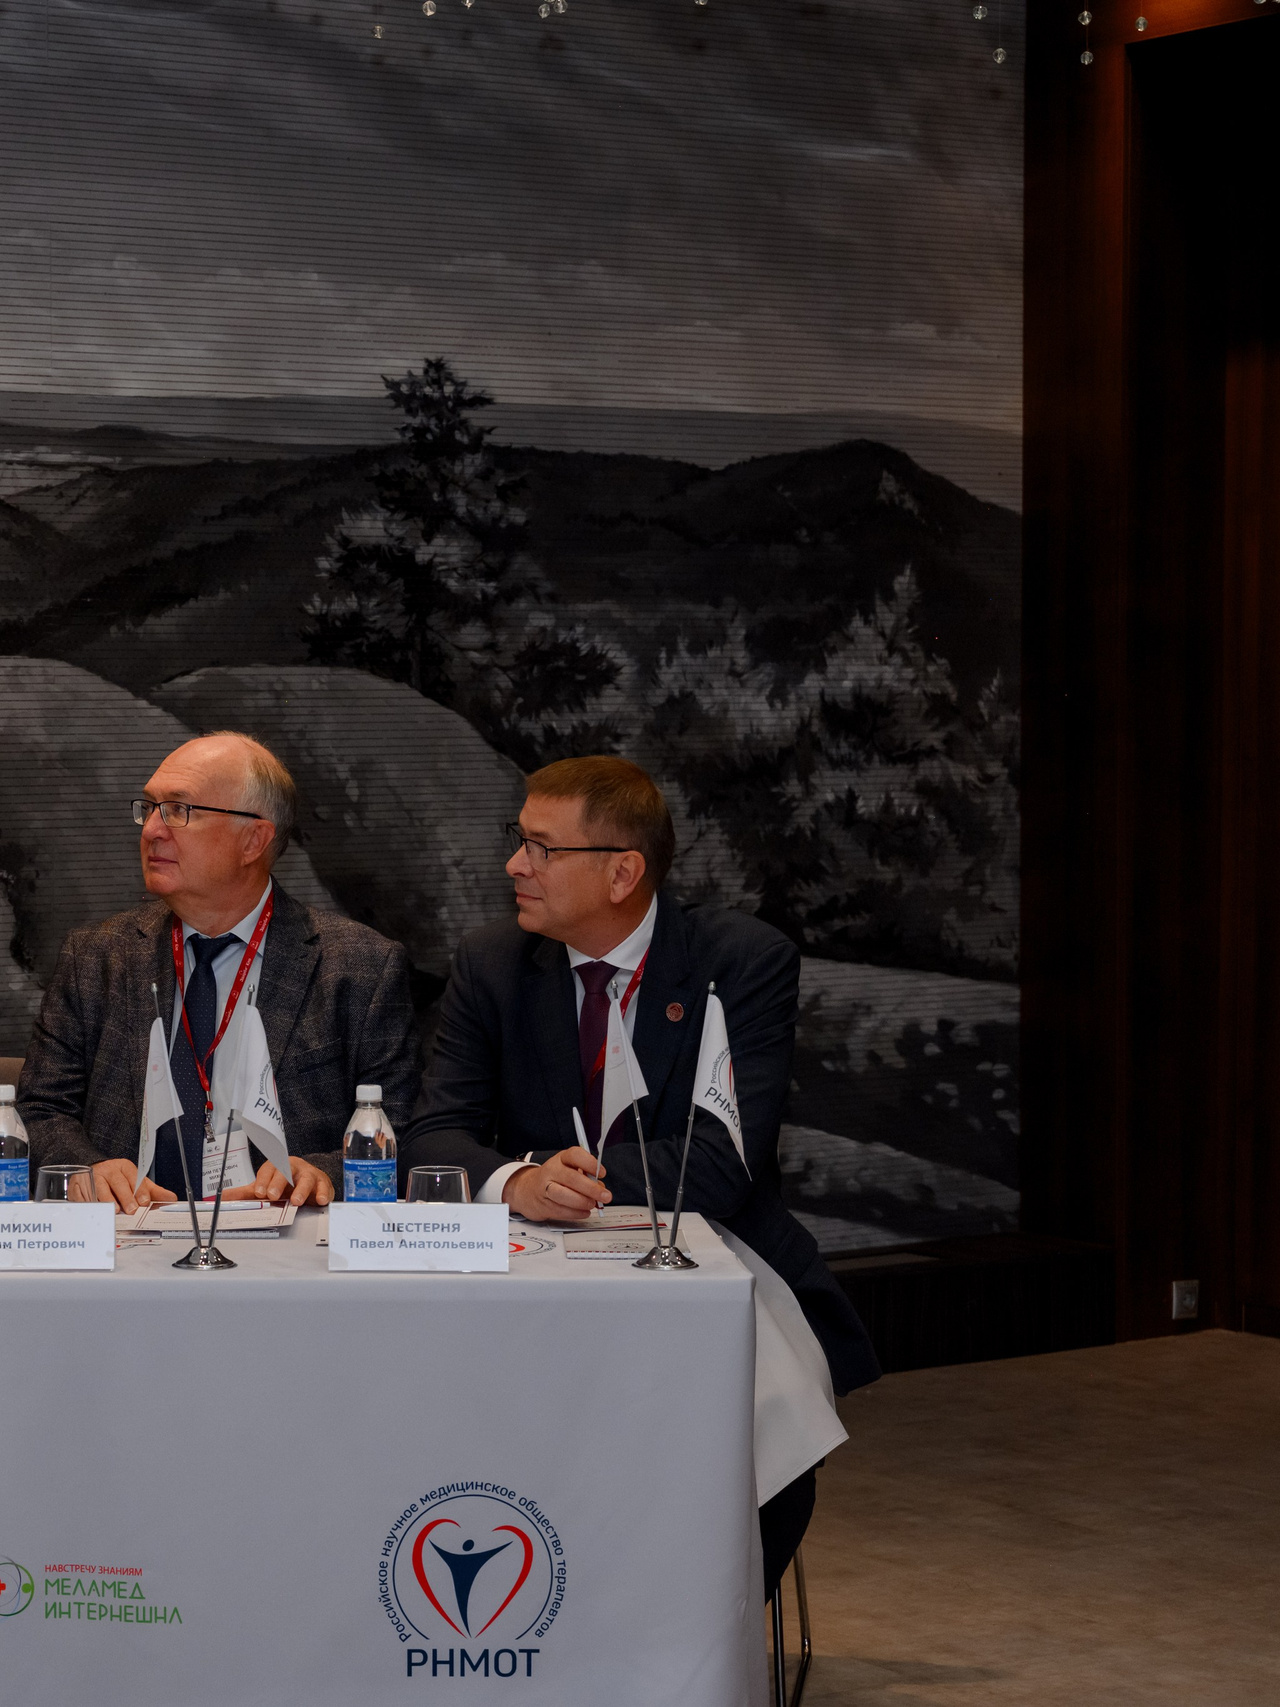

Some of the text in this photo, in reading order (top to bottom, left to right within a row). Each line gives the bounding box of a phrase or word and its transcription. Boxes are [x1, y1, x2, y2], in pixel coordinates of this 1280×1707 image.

[704, 1086, 741, 1134] РНМО
[0, 1222, 53, 1233] МИХИН
[381, 1222, 461, 1233] ШЕСТЕРНЯ
[17, 1239, 85, 1251] Петрович
[349, 1237, 494, 1251] Павел Анатольевич
[44, 1564, 143, 1577] НАВСТРЕЧУ ЗНАНИЯМ
[378, 1481, 567, 1643] Российское научное медицинское общество терапевтов
[45, 1578, 146, 1600] МЕЛАМЕД
[45, 1601, 183, 1624] ИНТЕРНЕШНЛ
[406, 1648, 540, 1677] РНМОТ
